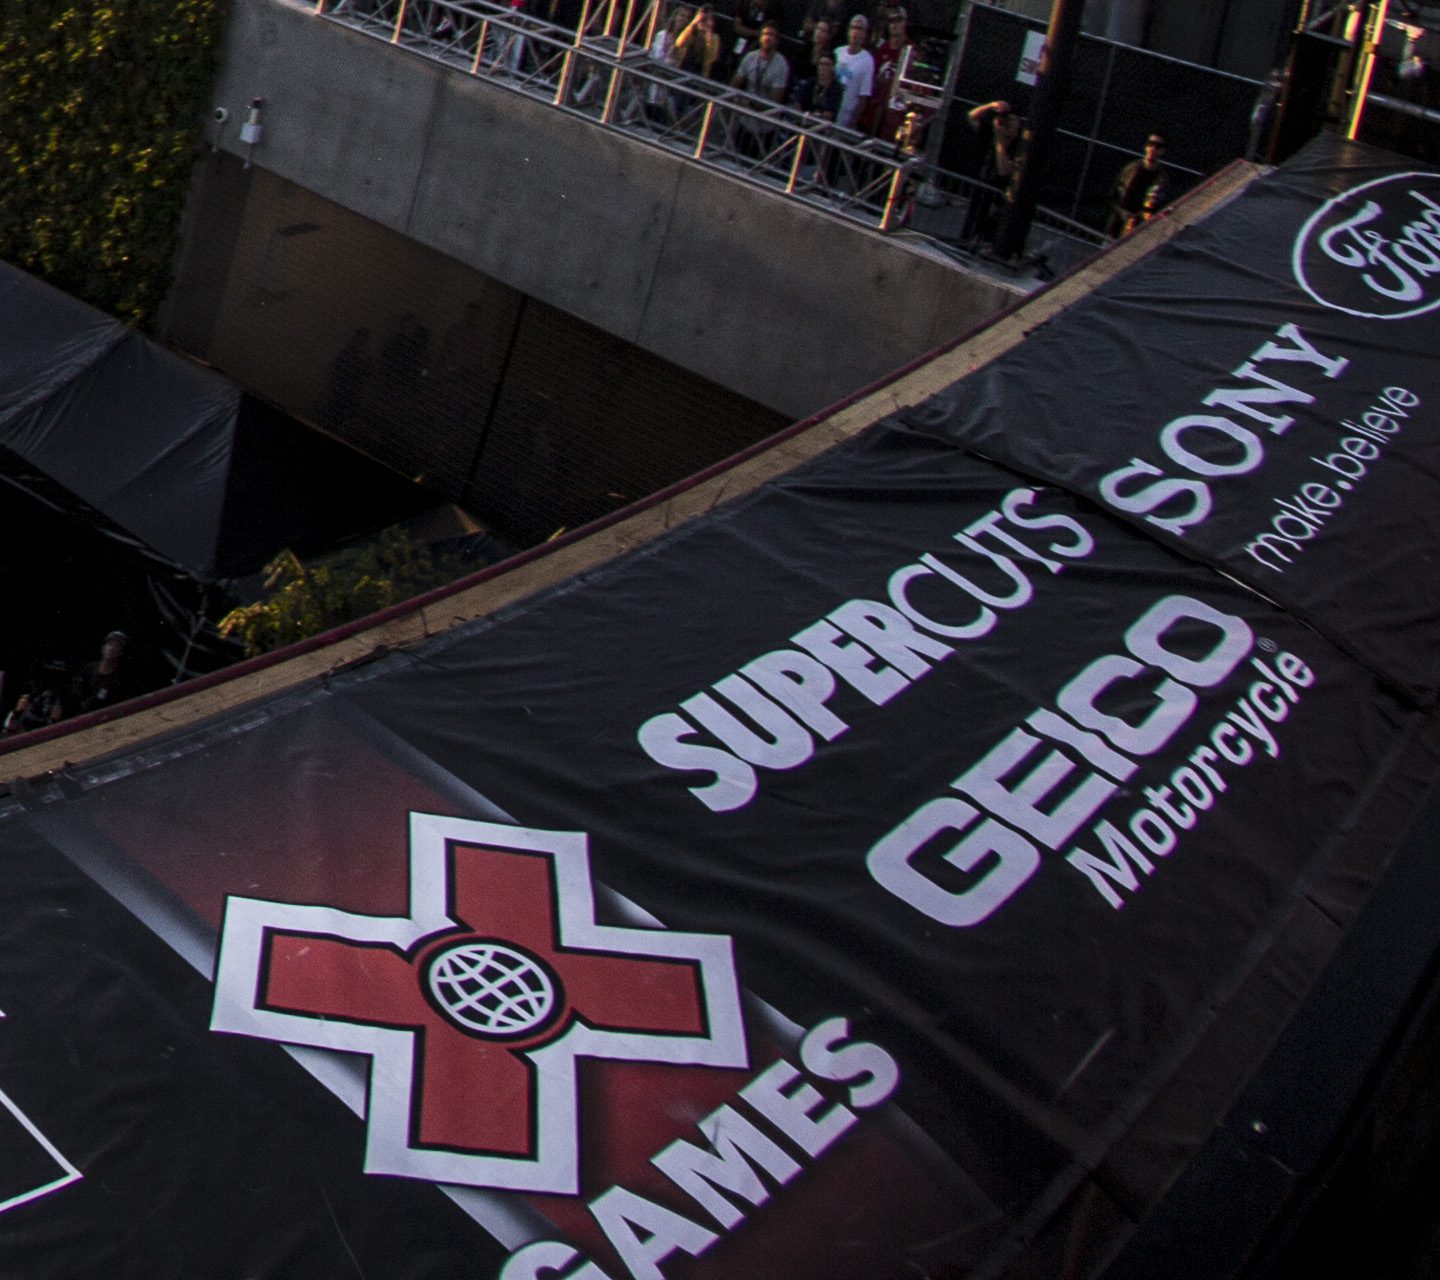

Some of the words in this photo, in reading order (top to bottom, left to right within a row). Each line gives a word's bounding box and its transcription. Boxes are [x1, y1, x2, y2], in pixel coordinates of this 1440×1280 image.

[1100, 324, 1351, 537] SONY
[1244, 383, 1421, 573] make.believe
[637, 485, 1095, 813] SUPERCUTS
[866, 594, 1255, 928] GEICO
[1064, 648, 1316, 910] Motorcycle
